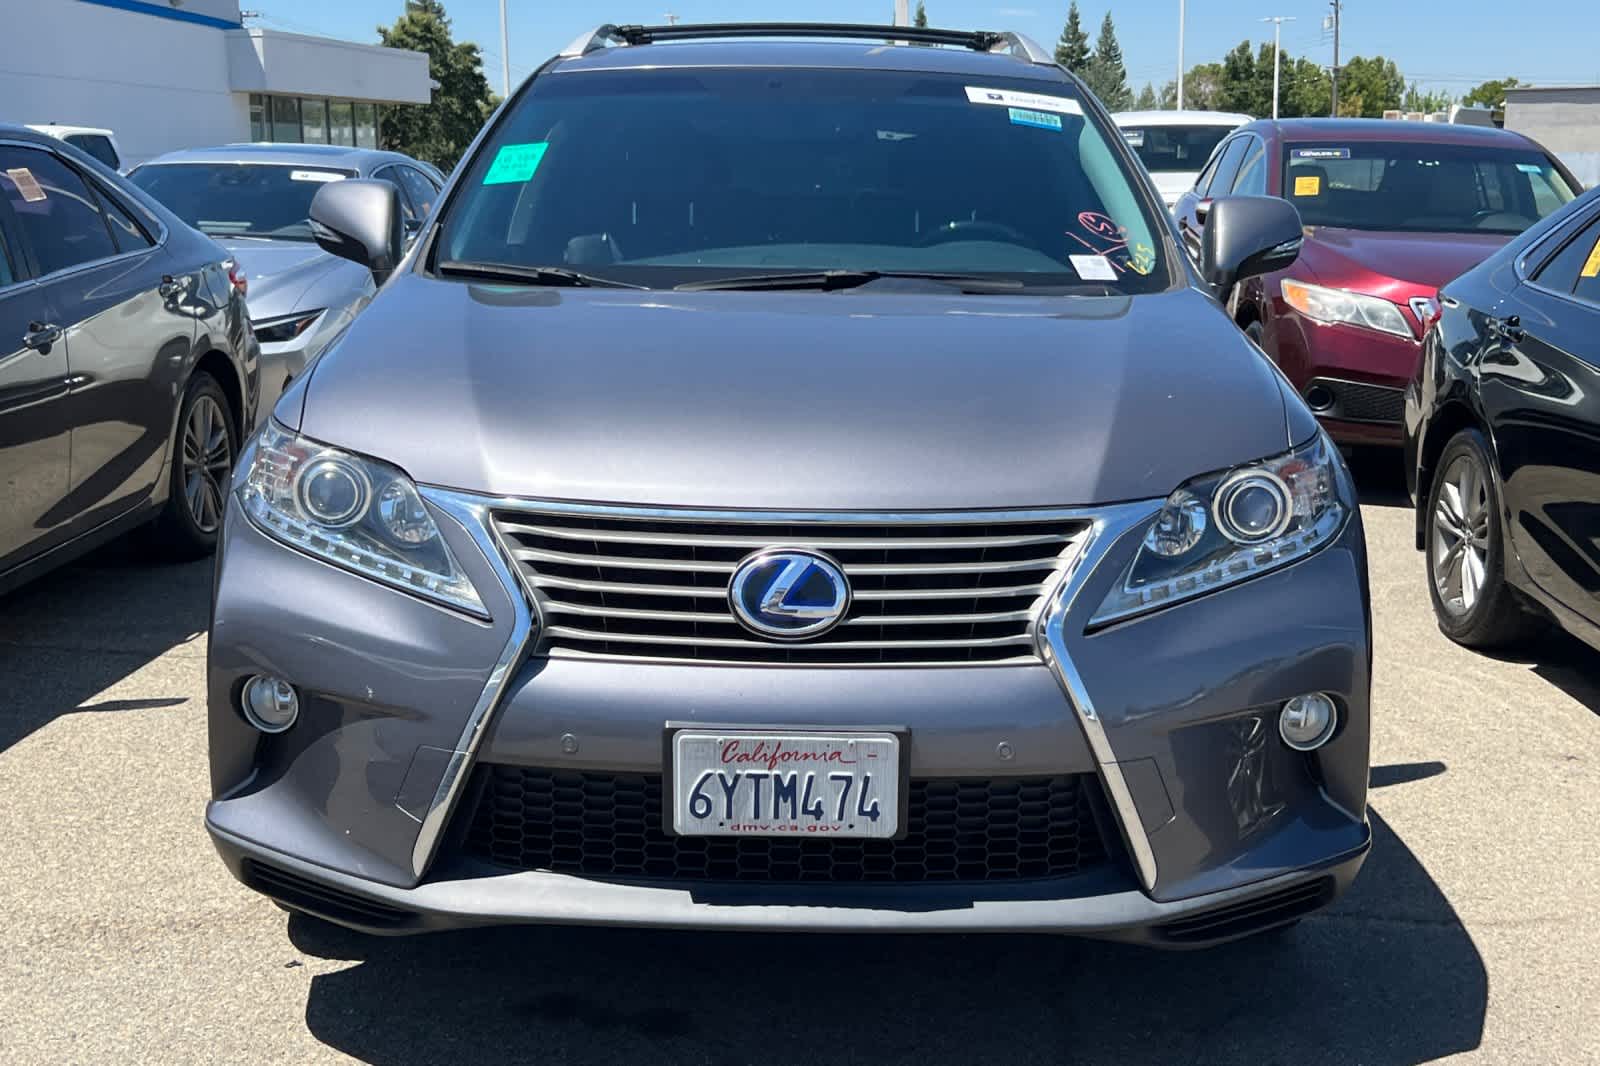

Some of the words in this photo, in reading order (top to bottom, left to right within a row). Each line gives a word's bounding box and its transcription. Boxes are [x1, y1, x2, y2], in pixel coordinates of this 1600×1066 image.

[720, 740, 856, 770] California
[688, 770, 881, 822] 6YTM474
[730, 823, 841, 832] dmv.ca.gov
